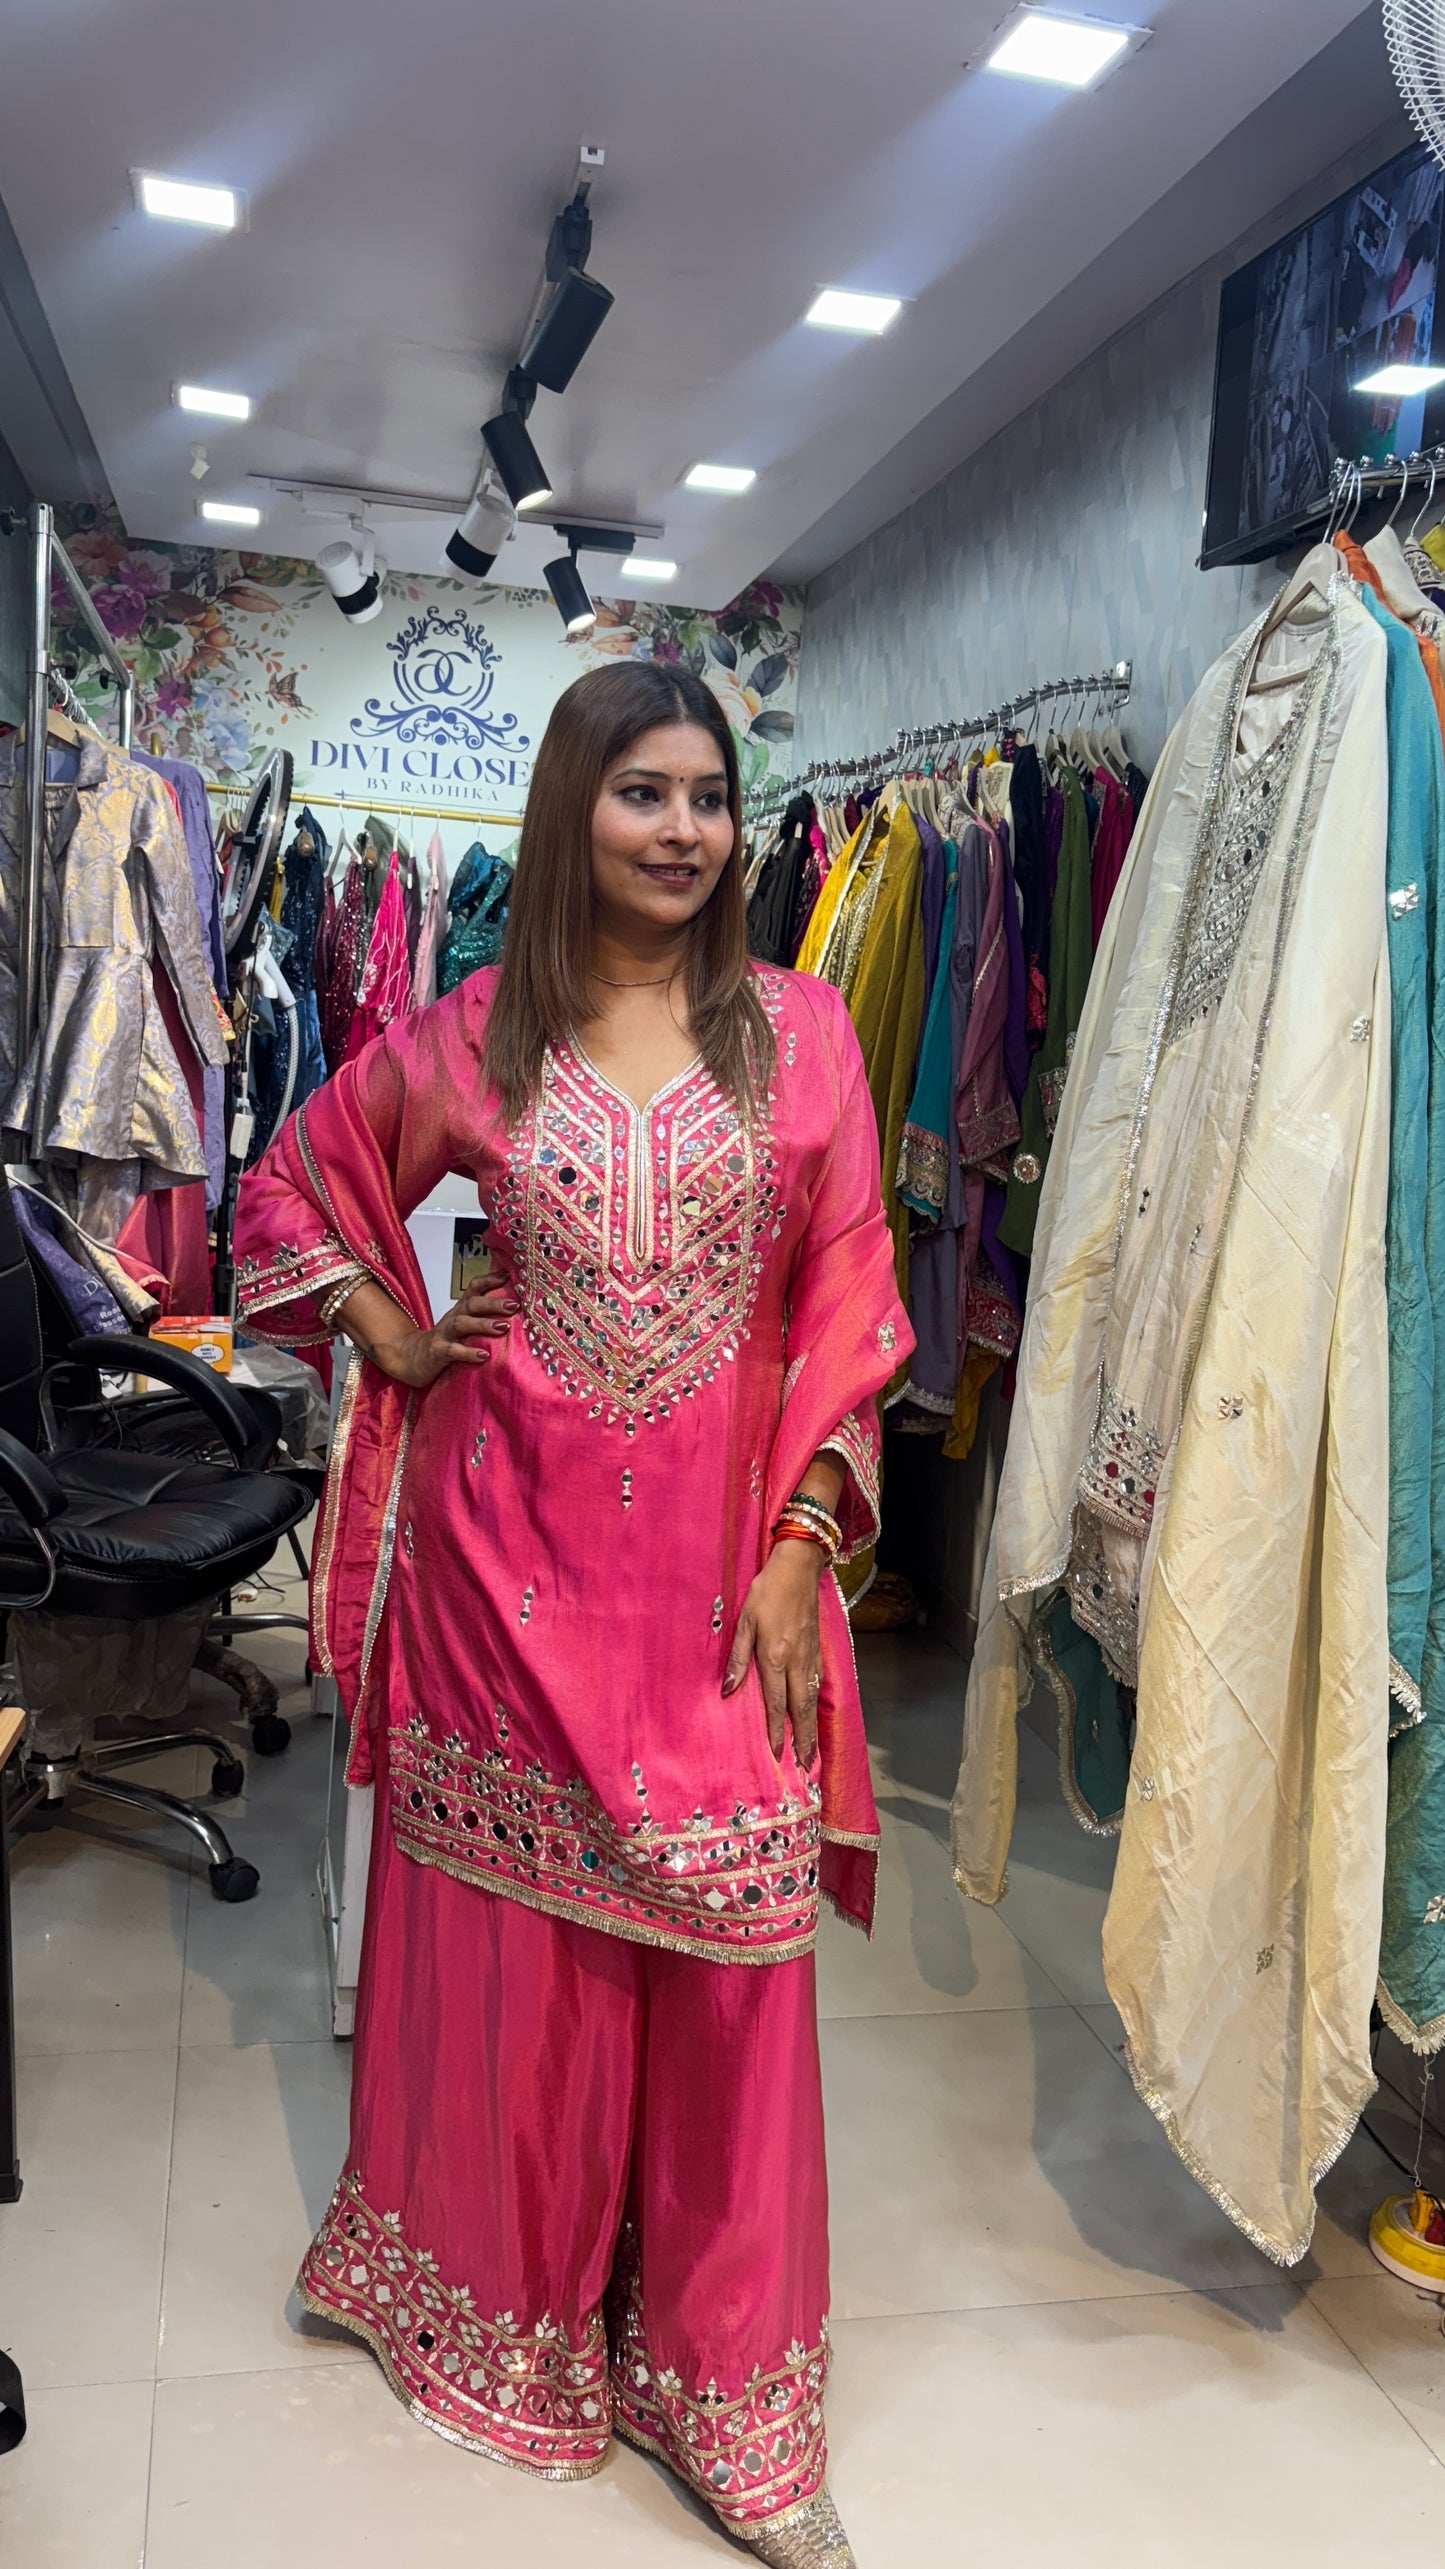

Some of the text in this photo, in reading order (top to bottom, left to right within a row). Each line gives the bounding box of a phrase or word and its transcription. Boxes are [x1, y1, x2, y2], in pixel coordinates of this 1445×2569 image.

[310, 739, 535, 788] DIVI CLOSE
[367, 777, 499, 802] BY RADHIKA
